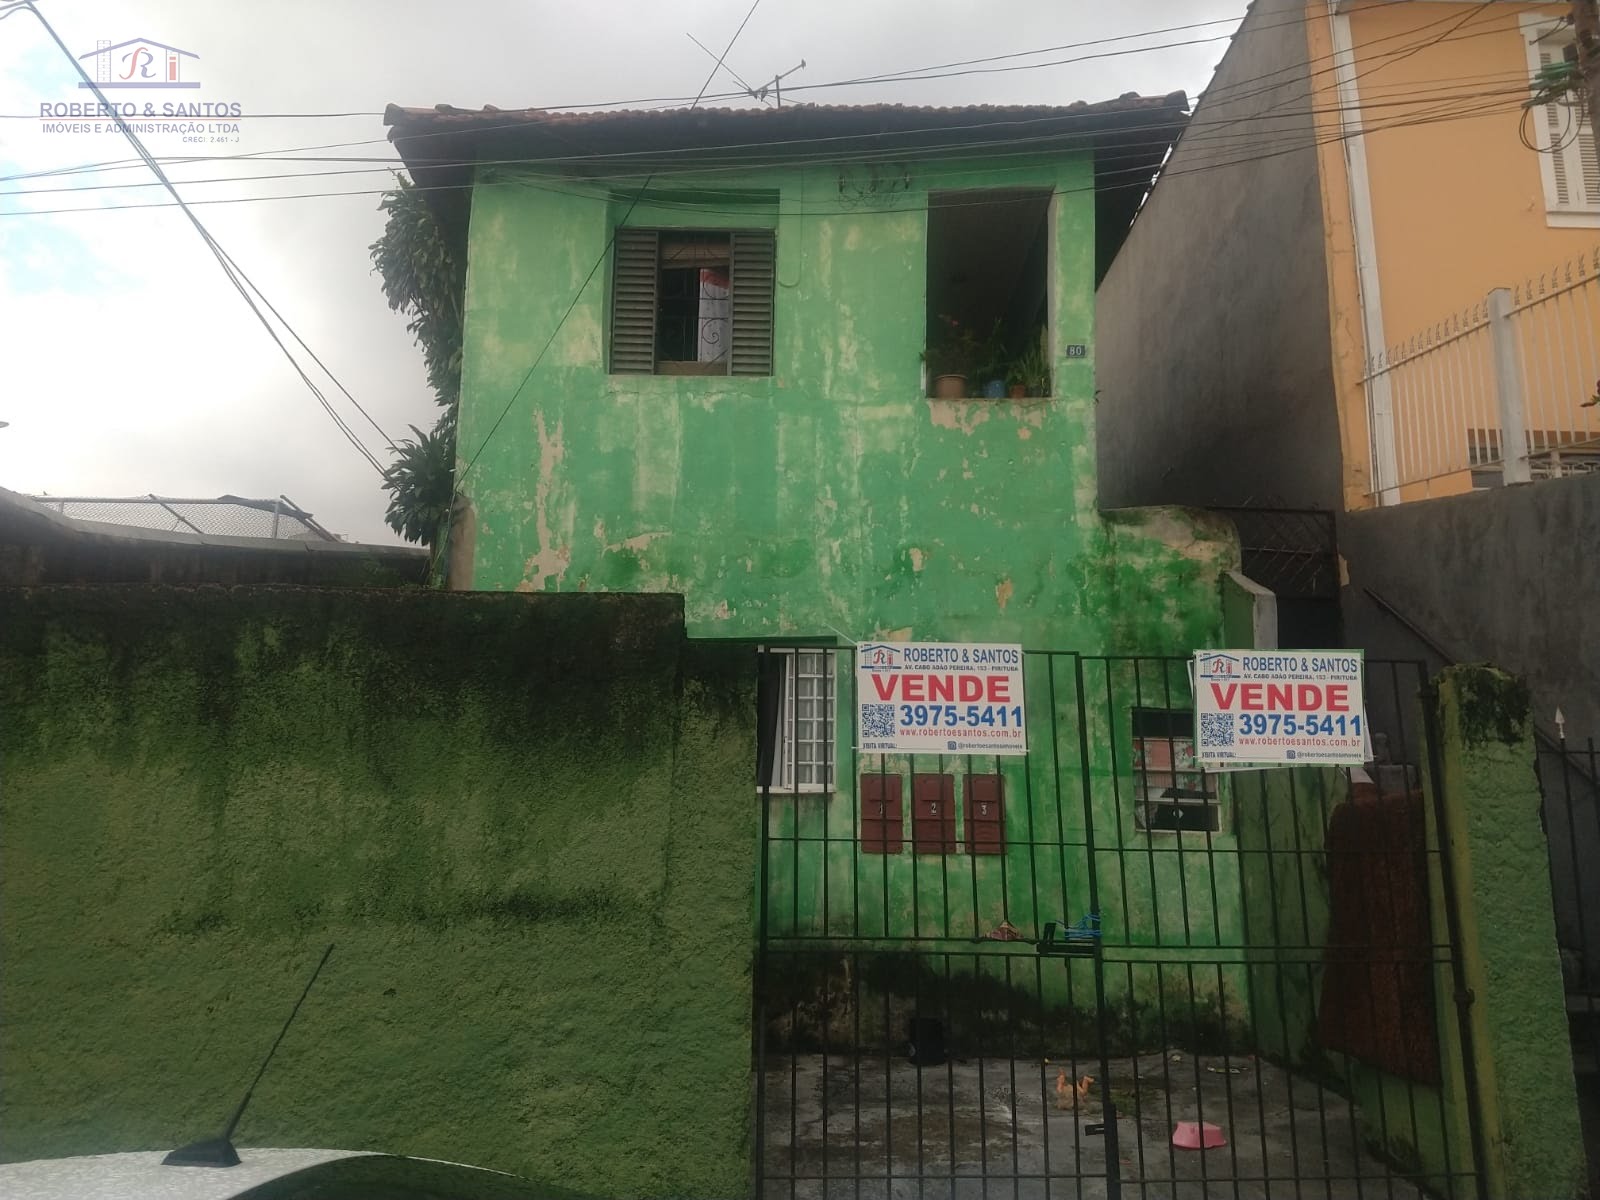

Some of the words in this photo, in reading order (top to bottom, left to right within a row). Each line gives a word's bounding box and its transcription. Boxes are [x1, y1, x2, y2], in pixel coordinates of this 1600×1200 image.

[1069, 346, 1082, 356] 80
[903, 647, 959, 663] ROBERTO
[961, 648, 970, 663] &
[972, 648, 1019, 664] SANTOS
[1242, 656, 1298, 672] ROBERTO
[1300, 657, 1309, 672] &
[1311, 657, 1358, 673] SANTOS
[871, 674, 1011, 703] VENDE
[1210, 683, 1350, 712] VENDE
[899, 704, 1022, 728] 3975-5411
[899, 728, 1022, 738] www.robertoesantos.com.br
[1239, 713, 1361, 737] 3975-5411
[1238, 737, 1361, 747] www.robertoesantos.com.br
[930, 802, 937, 814] 2
[981, 804, 987, 815] 3
